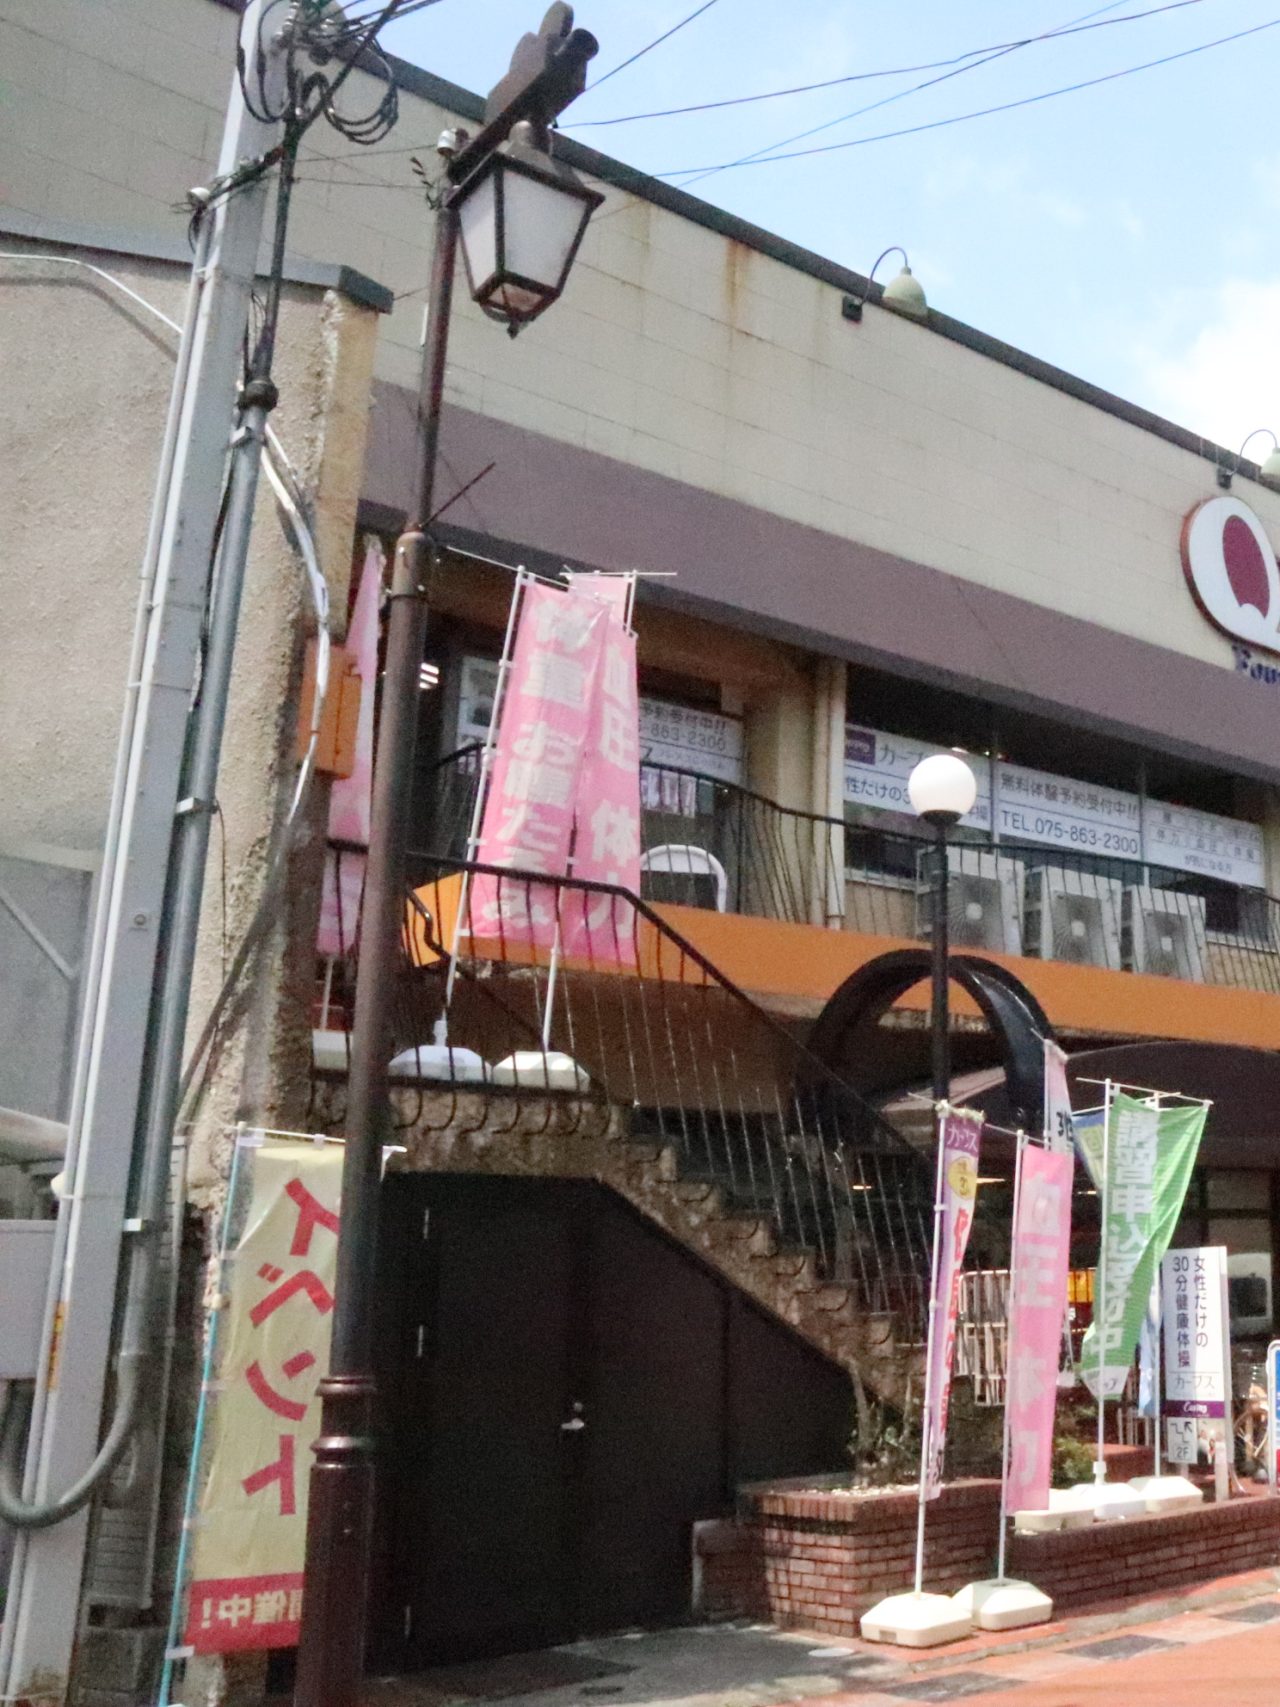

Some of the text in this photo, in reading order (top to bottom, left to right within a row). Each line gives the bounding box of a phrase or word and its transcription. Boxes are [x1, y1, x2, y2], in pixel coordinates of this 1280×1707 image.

[1002, 810, 1139, 855] TEL.075-863-2300
[1172, 1255, 1191, 1369] 30分健康体操
[1193, 1256, 1209, 1348] 女性だけの
[1177, 1446, 1190, 1459] 2F
